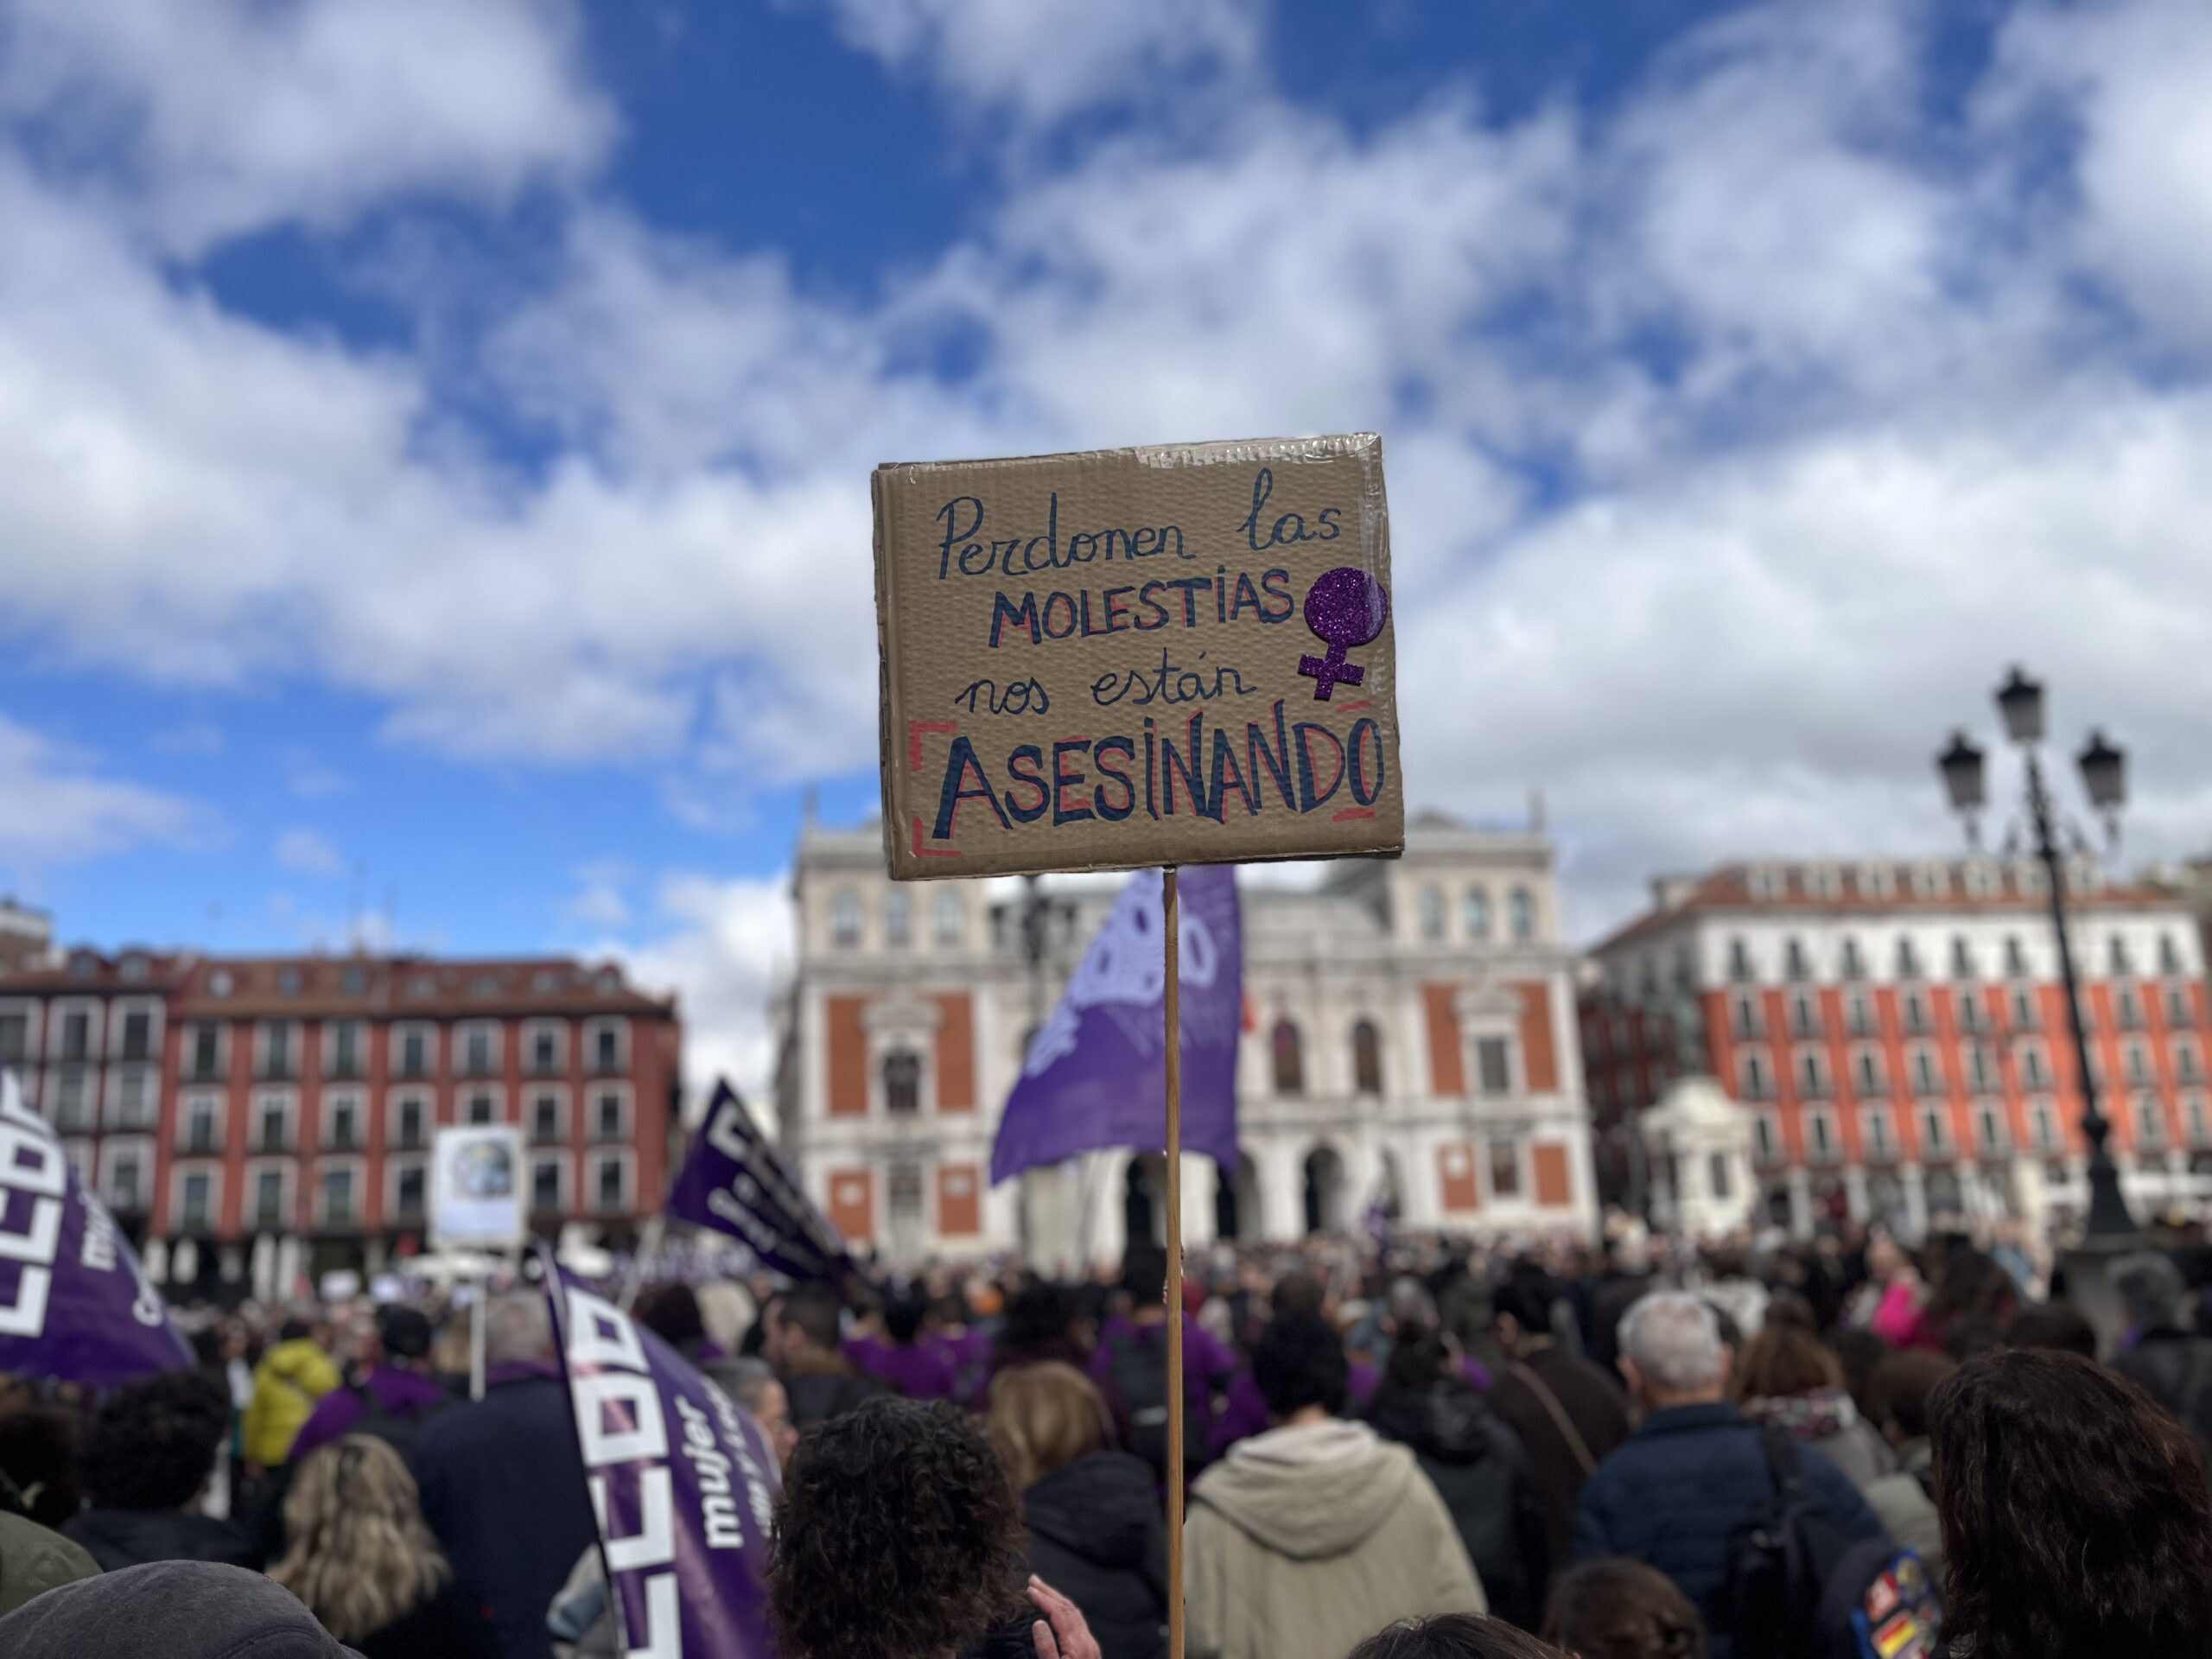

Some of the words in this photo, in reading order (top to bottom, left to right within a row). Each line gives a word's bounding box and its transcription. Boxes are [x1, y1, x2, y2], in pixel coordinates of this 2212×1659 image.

[937, 493, 1196, 580] Perdonen
[1237, 467, 1341, 551] las
[955, 676, 1050, 715] nos
[1090, 646, 1258, 705] están
[674, 1394, 745, 1549] mujer
